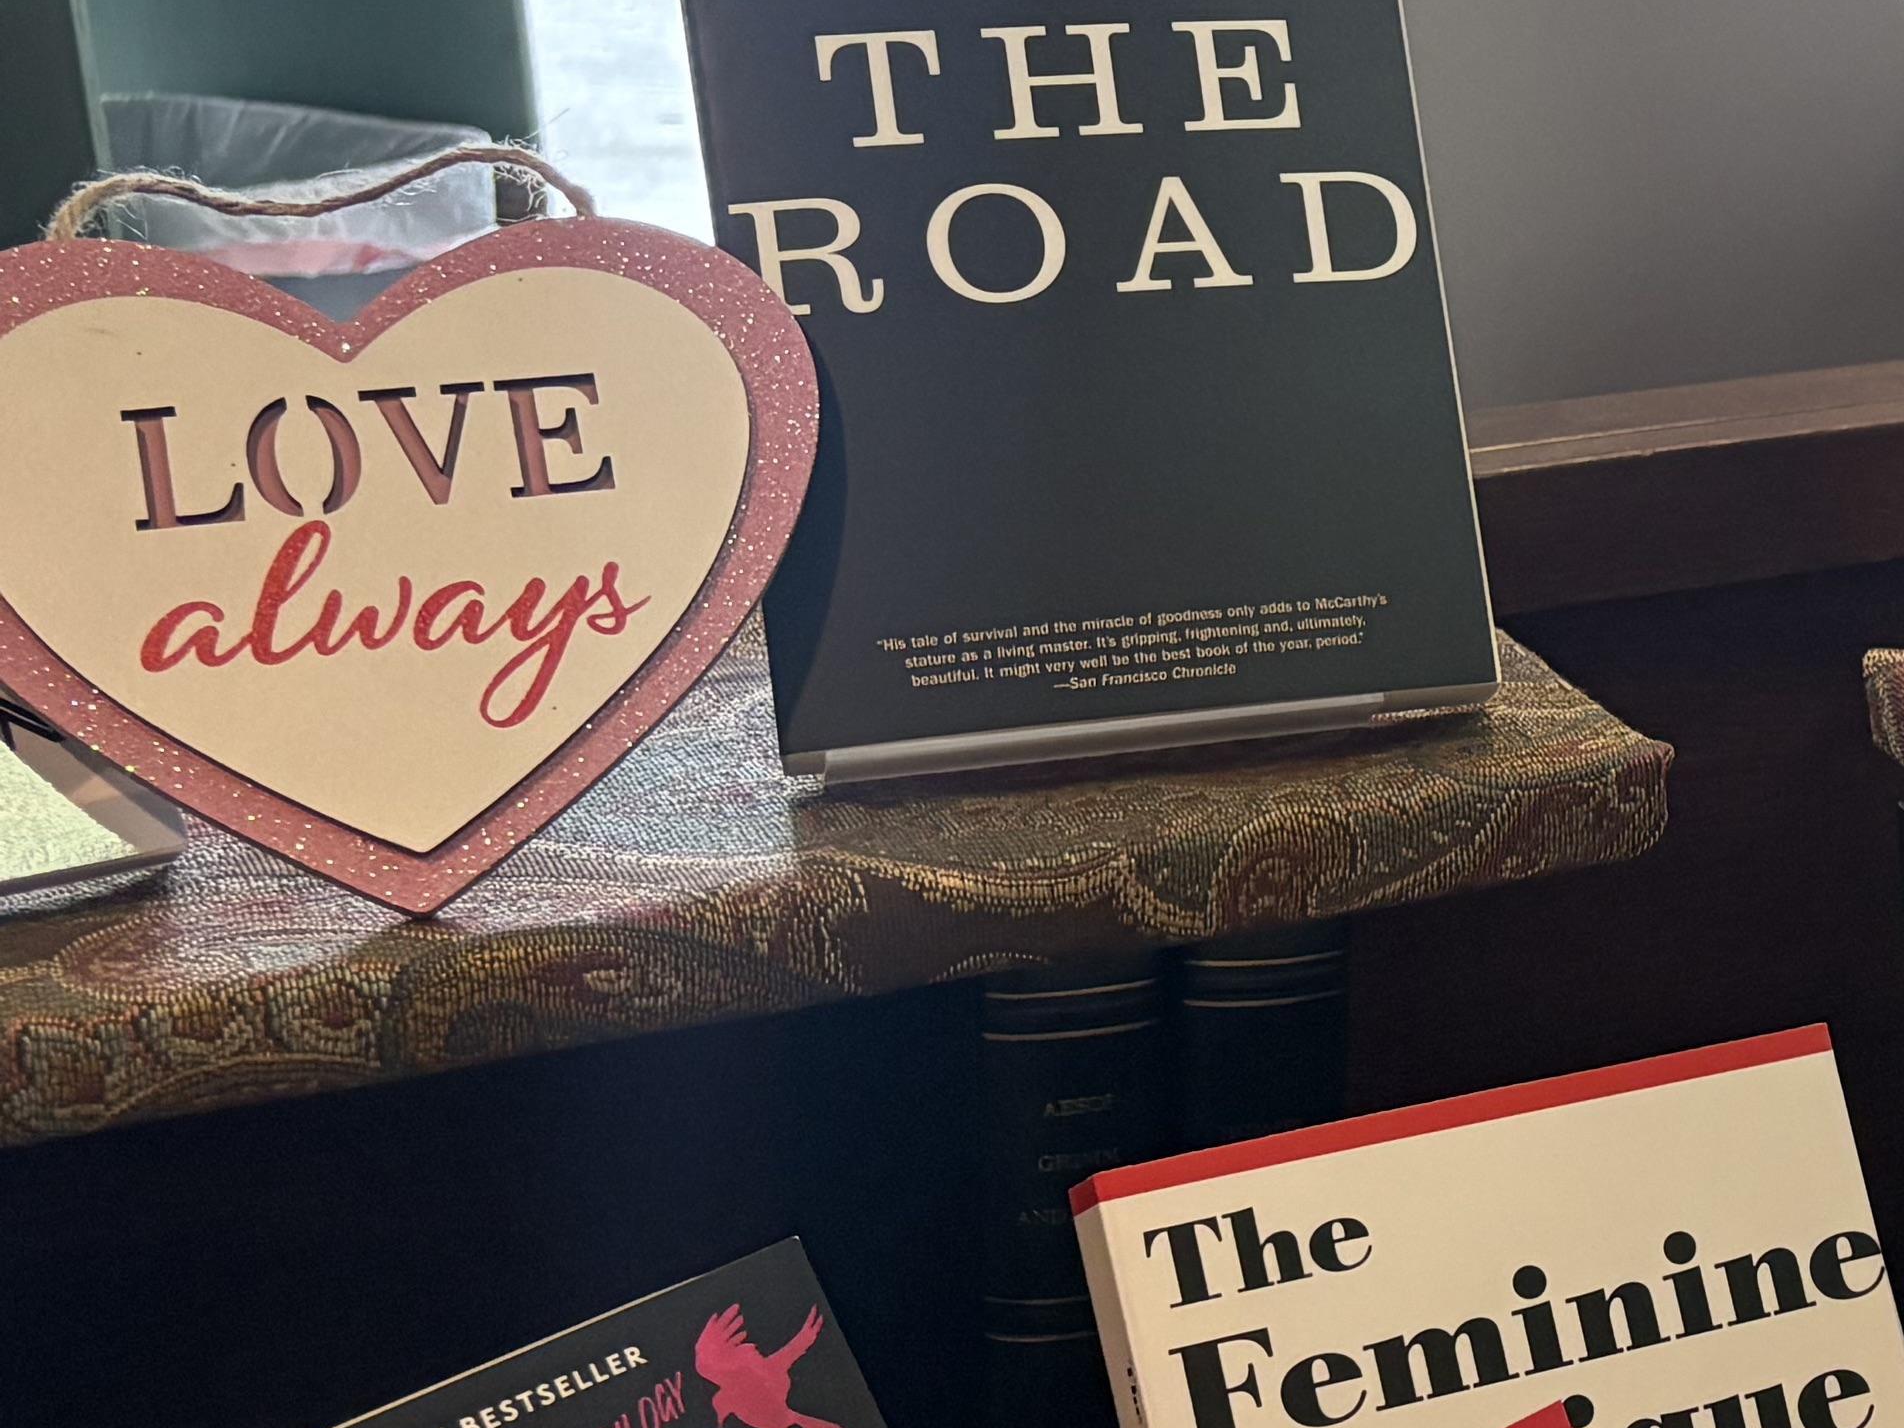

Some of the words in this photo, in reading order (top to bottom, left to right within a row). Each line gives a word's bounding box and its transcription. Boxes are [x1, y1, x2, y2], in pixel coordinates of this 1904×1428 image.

[813, 17, 1303, 149] THE
[726, 169, 1421, 318] ROAD
[118, 371, 618, 534] LOVE
[139, 519, 652, 730] always
[1101, 669, 1168, 688] Francisco
[1171, 663, 1237, 682] Chronicle
[1142, 1205, 1375, 1308] The
